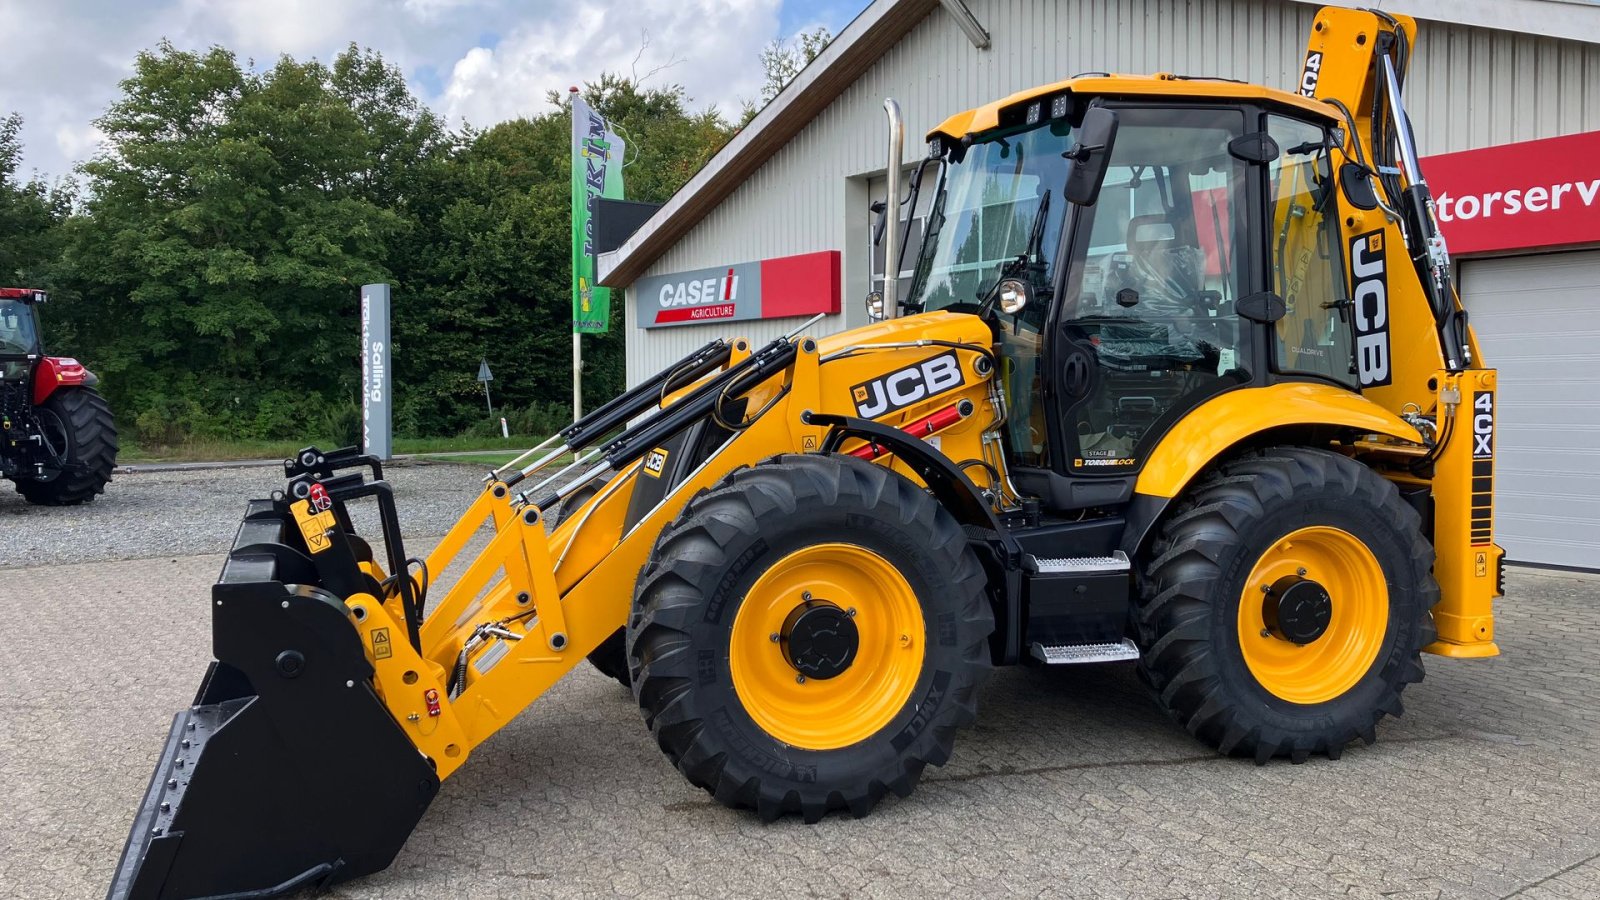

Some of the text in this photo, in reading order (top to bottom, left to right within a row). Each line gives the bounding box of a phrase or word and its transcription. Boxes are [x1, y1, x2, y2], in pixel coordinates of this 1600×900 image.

[659, 278, 717, 308] CASE
[690, 306, 733, 319] AGRICULTURE
[1352, 237, 1388, 385] JCB
[371, 341, 384, 403] Salling
[858, 355, 961, 418] JCB
[1474, 393, 1493, 454] 4CX
[903, 684, 946, 738] XMCL
